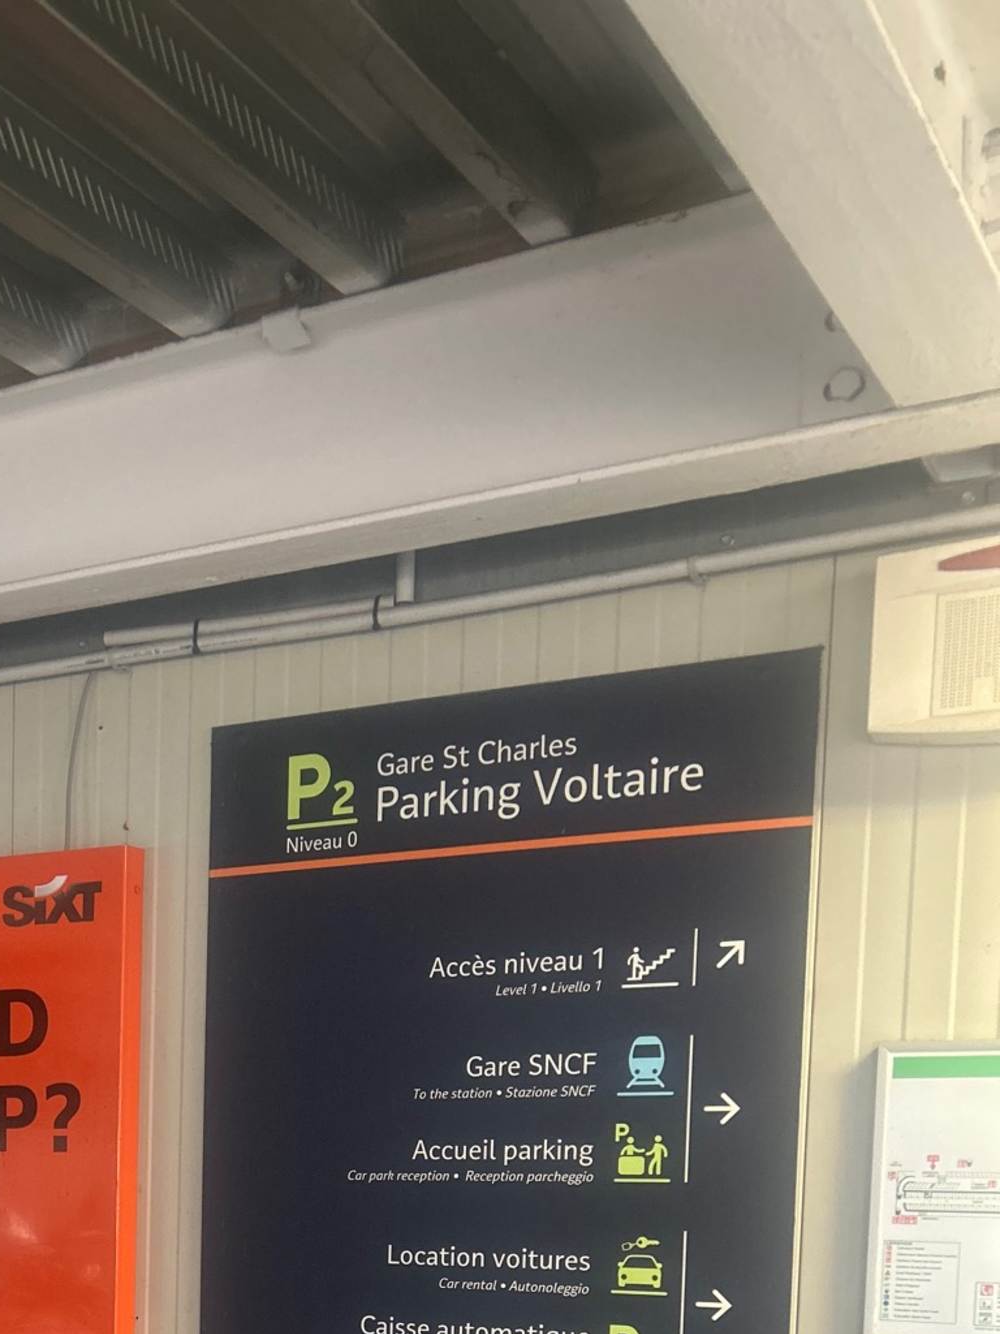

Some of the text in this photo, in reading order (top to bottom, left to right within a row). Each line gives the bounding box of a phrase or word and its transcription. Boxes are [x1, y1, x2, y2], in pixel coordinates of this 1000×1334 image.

[377, 734, 577, 776] Gare St Charles
[378, 757, 703, 821] Parking Voltaire
[287, 831, 357, 853] Niveau 0
[429, 948, 603, 978] Accès niveau 1
[496, 980, 601, 996] Level 1 Livello 1
[467, 1053, 597, 1077] Gare SNCF
[414, 1085, 596, 1099] To the station Stazione SNCF
[614, 1123, 629, 1142] P
[412, 1139, 593, 1166] Accueil parking
[348, 1170, 594, 1185] Car park reception Reception parcheggio
[388, 1245, 590, 1271] Location voitures
[439, 1277, 589, 1297] Car rental Autonoleggio
